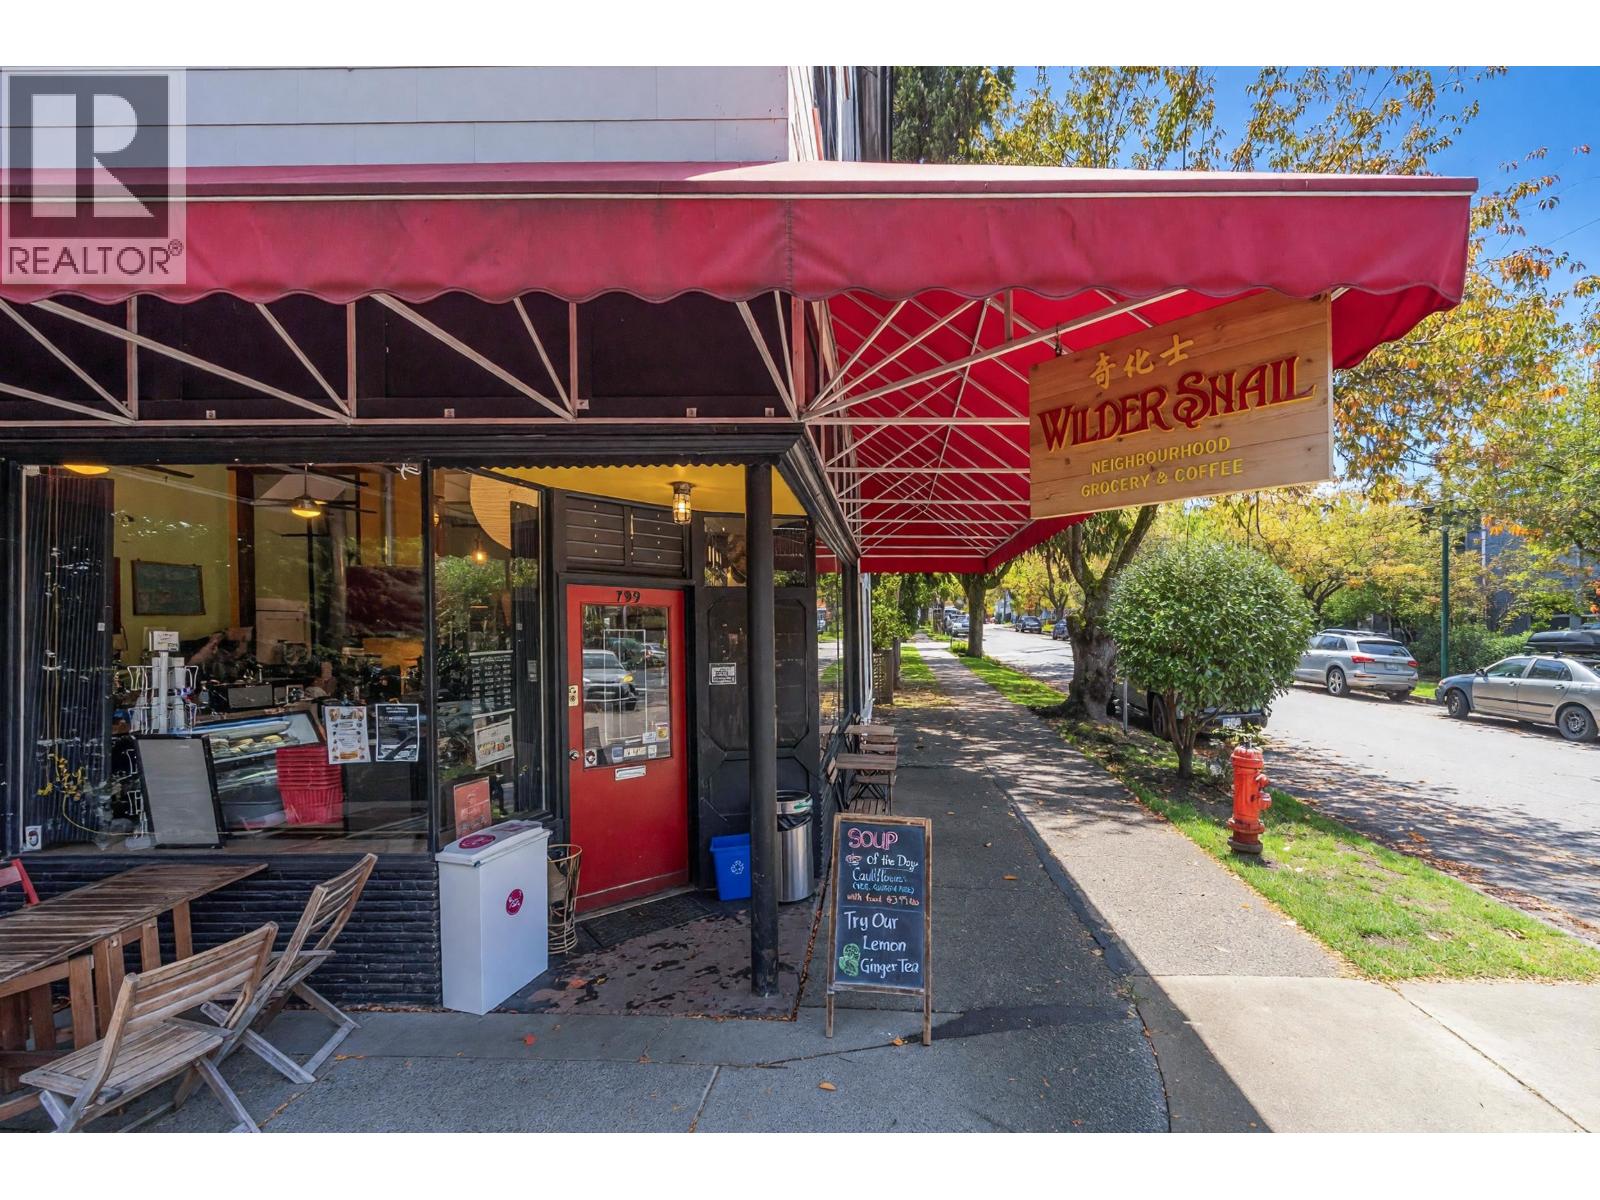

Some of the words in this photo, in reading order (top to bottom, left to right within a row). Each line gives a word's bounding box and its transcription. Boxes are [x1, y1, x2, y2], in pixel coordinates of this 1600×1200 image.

[1089, 333, 1194, 390] 奇化士
[1037, 385, 1175, 453] WILDER
[1172, 355, 1317, 429] SNAIL
[1091, 436, 1231, 476] NEIGHBOURHOOD
[1080, 474, 1150, 499] GROCERY
[1156, 471, 1169, 485] &
[1174, 458, 1244, 483] COFFEE
[615, 590, 641, 604] 799
[847, 826, 899, 850] SOUP
[866, 852, 879, 865] of
[881, 854, 895, 866] the
[897, 854, 919, 872] Day
[844, 911, 868, 932] Try
[871, 912, 899, 930] Our
[863, 935, 906, 952] Lemon
[860, 958, 897, 979] Ginger
[897, 958, 919, 974] Tea
